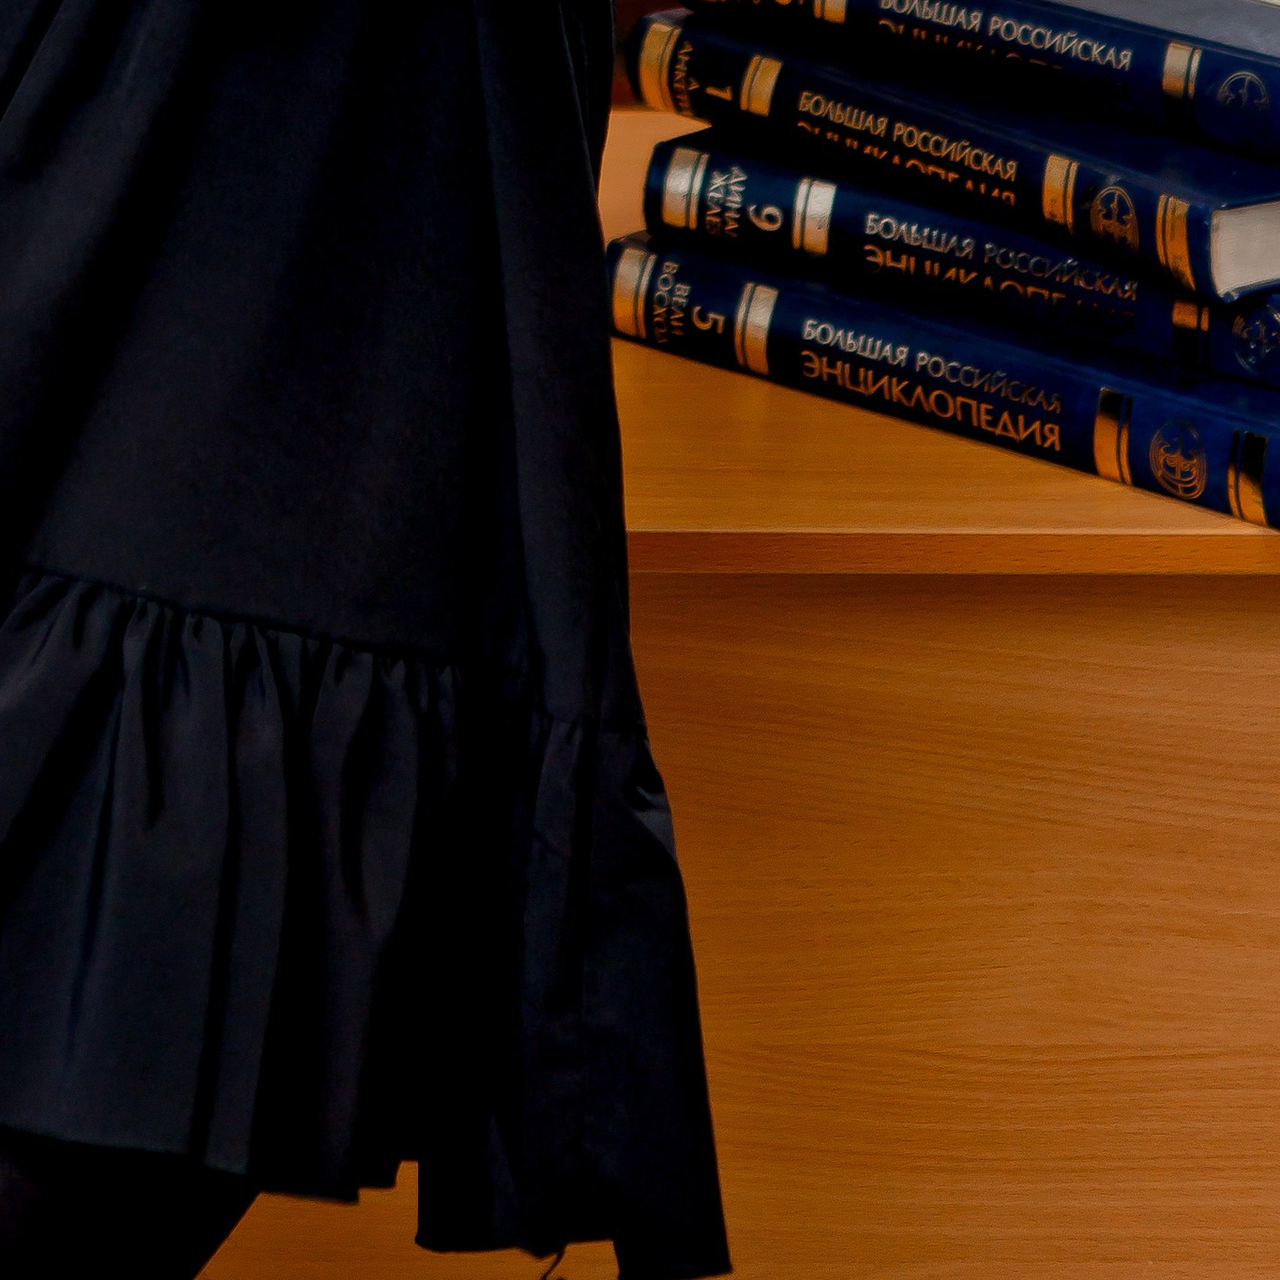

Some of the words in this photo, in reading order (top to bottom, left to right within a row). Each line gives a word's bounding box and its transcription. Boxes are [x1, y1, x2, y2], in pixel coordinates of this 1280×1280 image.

[988, 15, 1133, 72] РОССИЙСКАЯ
[705, 86, 733, 101] 1
[798, 91, 888, 138] БОЛЬШАЯ
[892, 122, 1018, 182] РОССИЙСКАЯ
[748, 204, 783, 231] 9
[864, 212, 975, 260] БОЛЬШАЯ
[984, 242, 1137, 301] РОССИЙСКАЯ
[692, 305, 726, 334] 5
[801, 350, 1061, 451] ЭНЦИКЛОПЕДИЯ
[802, 319, 909, 367] БОЛЬШАЯ
[915, 351, 1062, 414] РОССИЙСКАЯ
